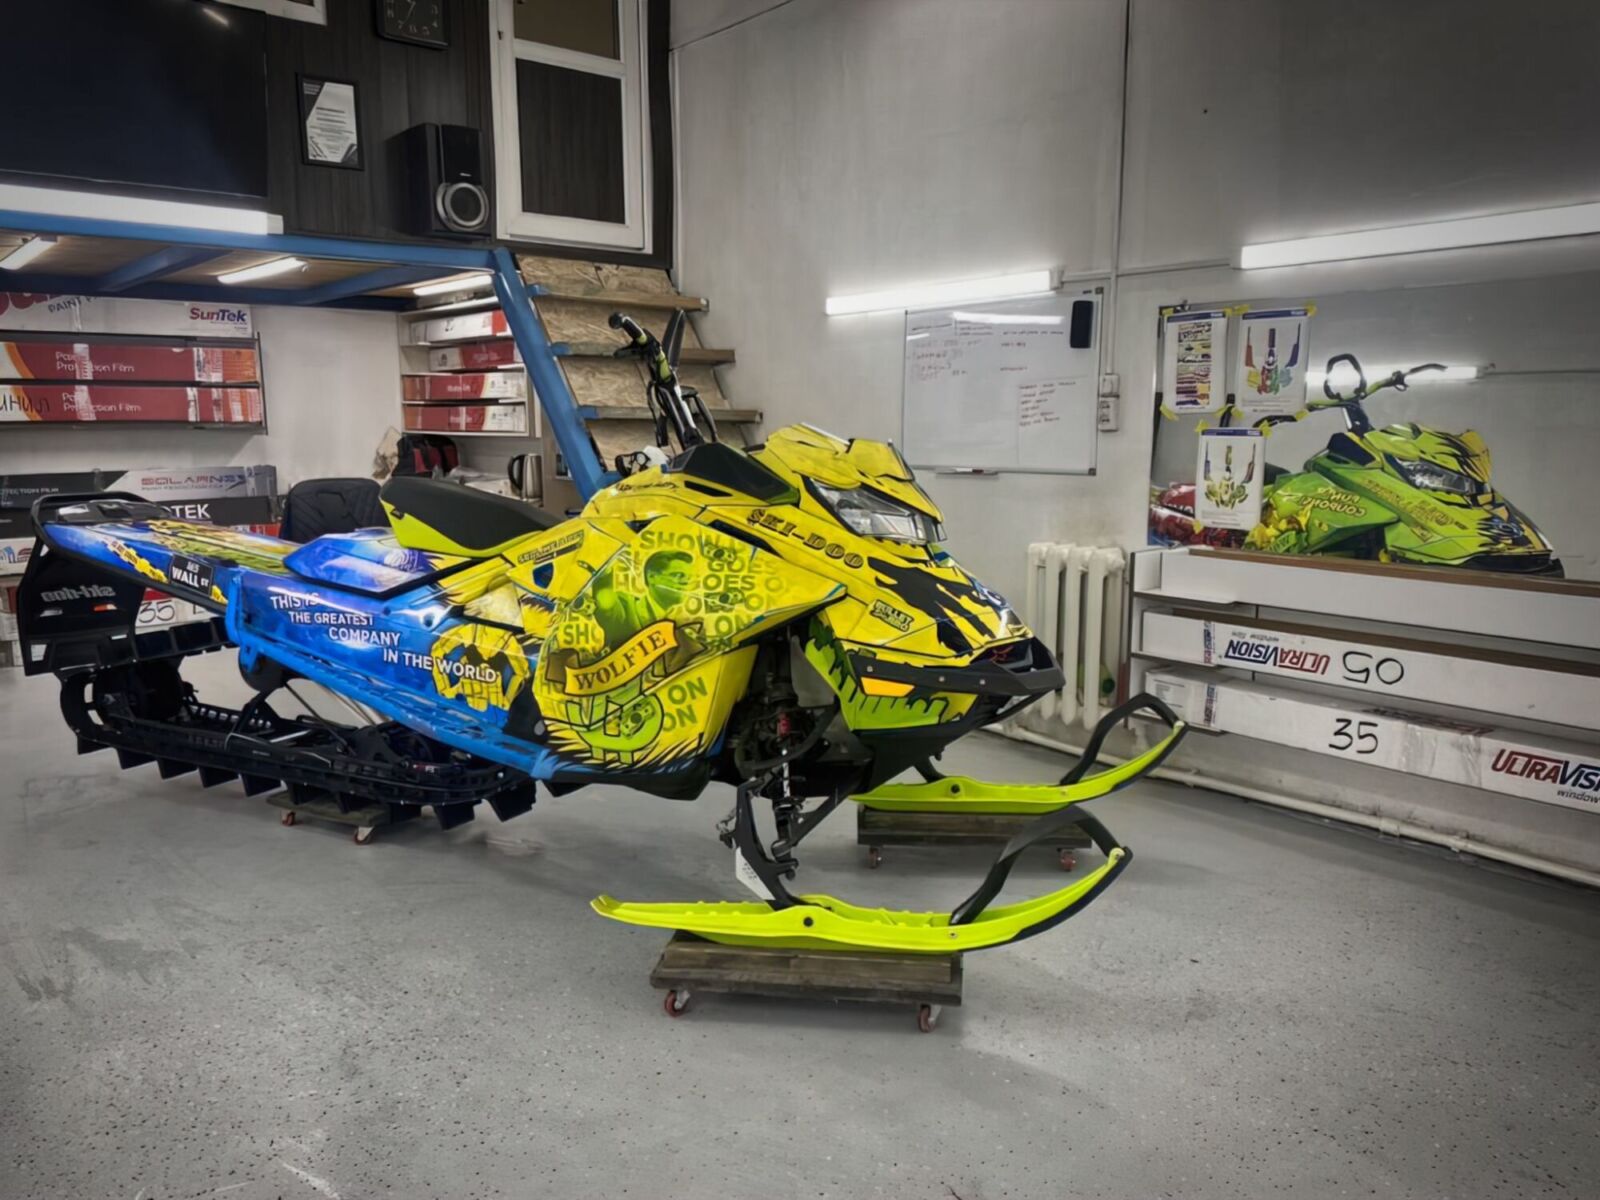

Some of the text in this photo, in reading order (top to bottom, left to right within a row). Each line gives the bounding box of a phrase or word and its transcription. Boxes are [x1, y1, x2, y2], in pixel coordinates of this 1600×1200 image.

[190, 307, 247, 323] SunTek
[162, 503, 211, 518] TEK
[746, 507, 864, 569] SKI-DOO
[172, 566, 200, 588] WALL
[138, 600, 176, 623] 35
[270, 595, 301, 610] THIS
[288, 611, 374, 627] THE GREATEST
[329, 626, 401, 646] COMPANY
[383, 648, 498, 684] IN THE WORLD
[573, 629, 668, 690] WOLFIE
[1224, 639, 1331, 676] ULTRAVISION
[668, 676, 708, 705] ON
[1328, 718, 1379, 754] 35
